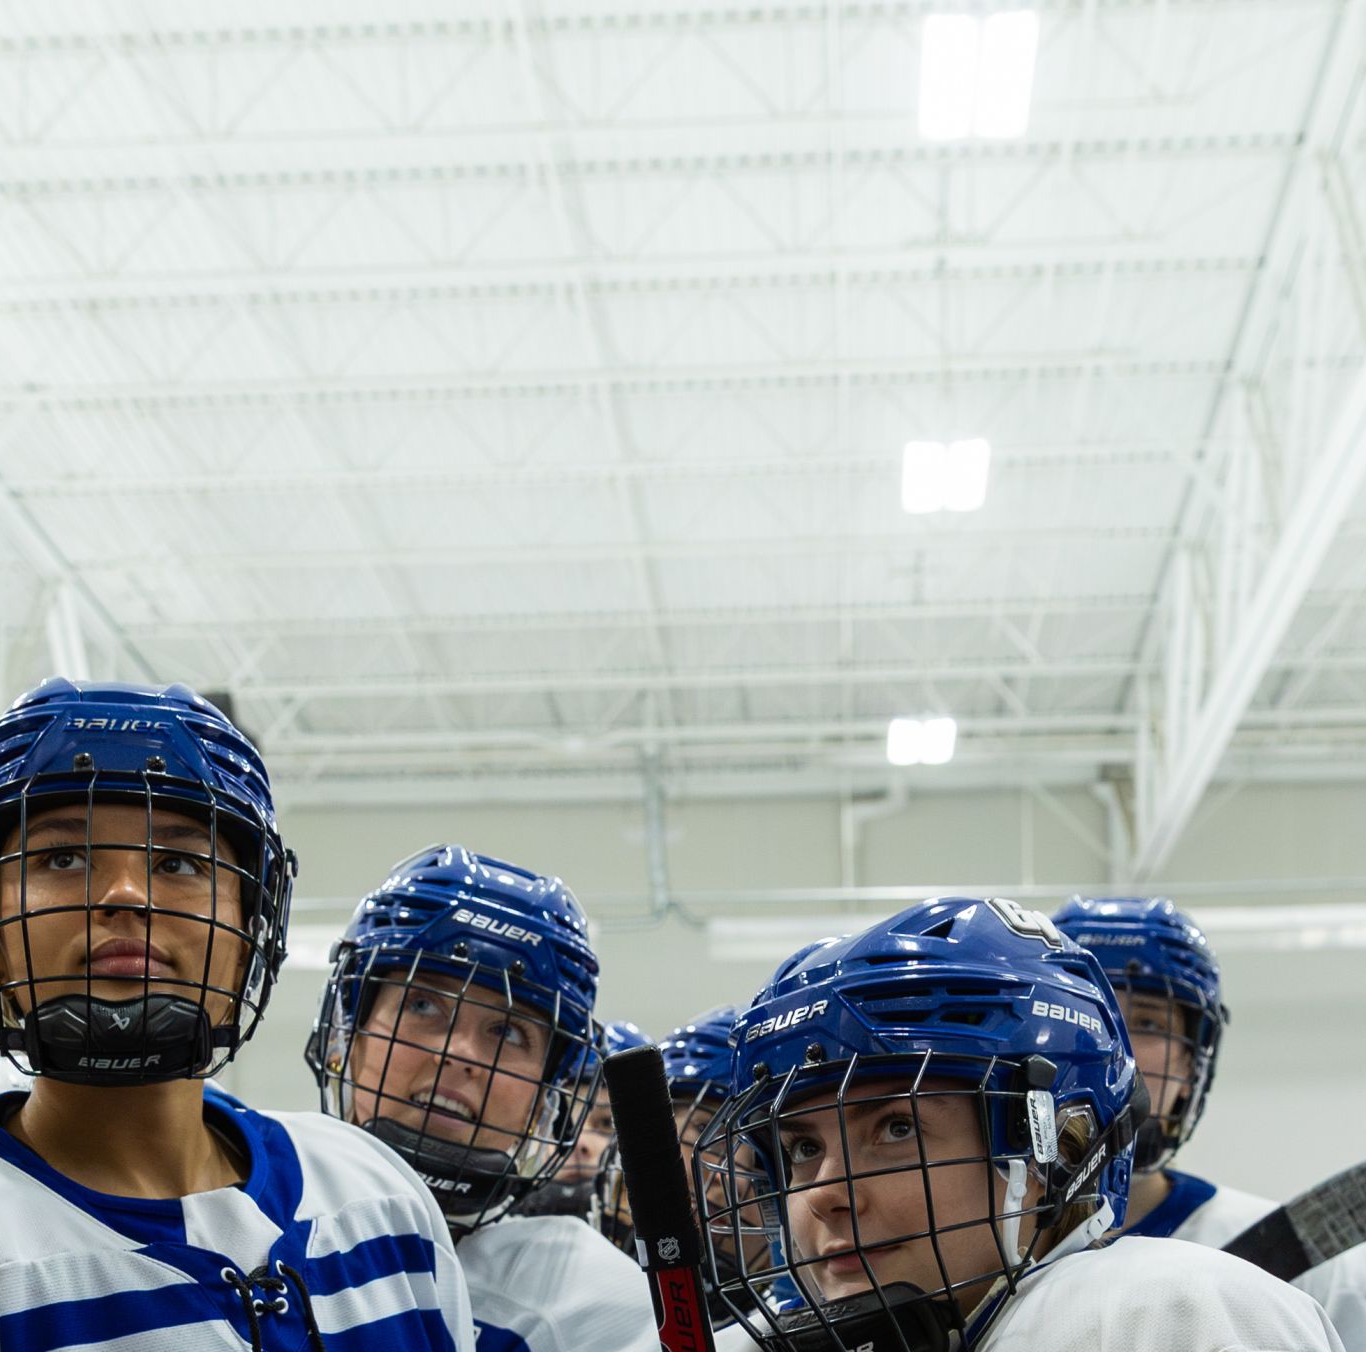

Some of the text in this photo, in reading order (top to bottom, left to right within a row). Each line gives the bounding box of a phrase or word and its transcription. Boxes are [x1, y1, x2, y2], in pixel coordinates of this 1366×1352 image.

[452, 908, 543, 946] BAUER
[745, 1000, 829, 1044] BAUER
[1032, 1001, 1103, 1034] BAUER
[78, 1055, 161, 1069] BAUER
[1029, 1099, 1043, 1155] BAUER
[418, 1173, 472, 1194] UER
[1065, 1143, 1107, 1203] BAUER
